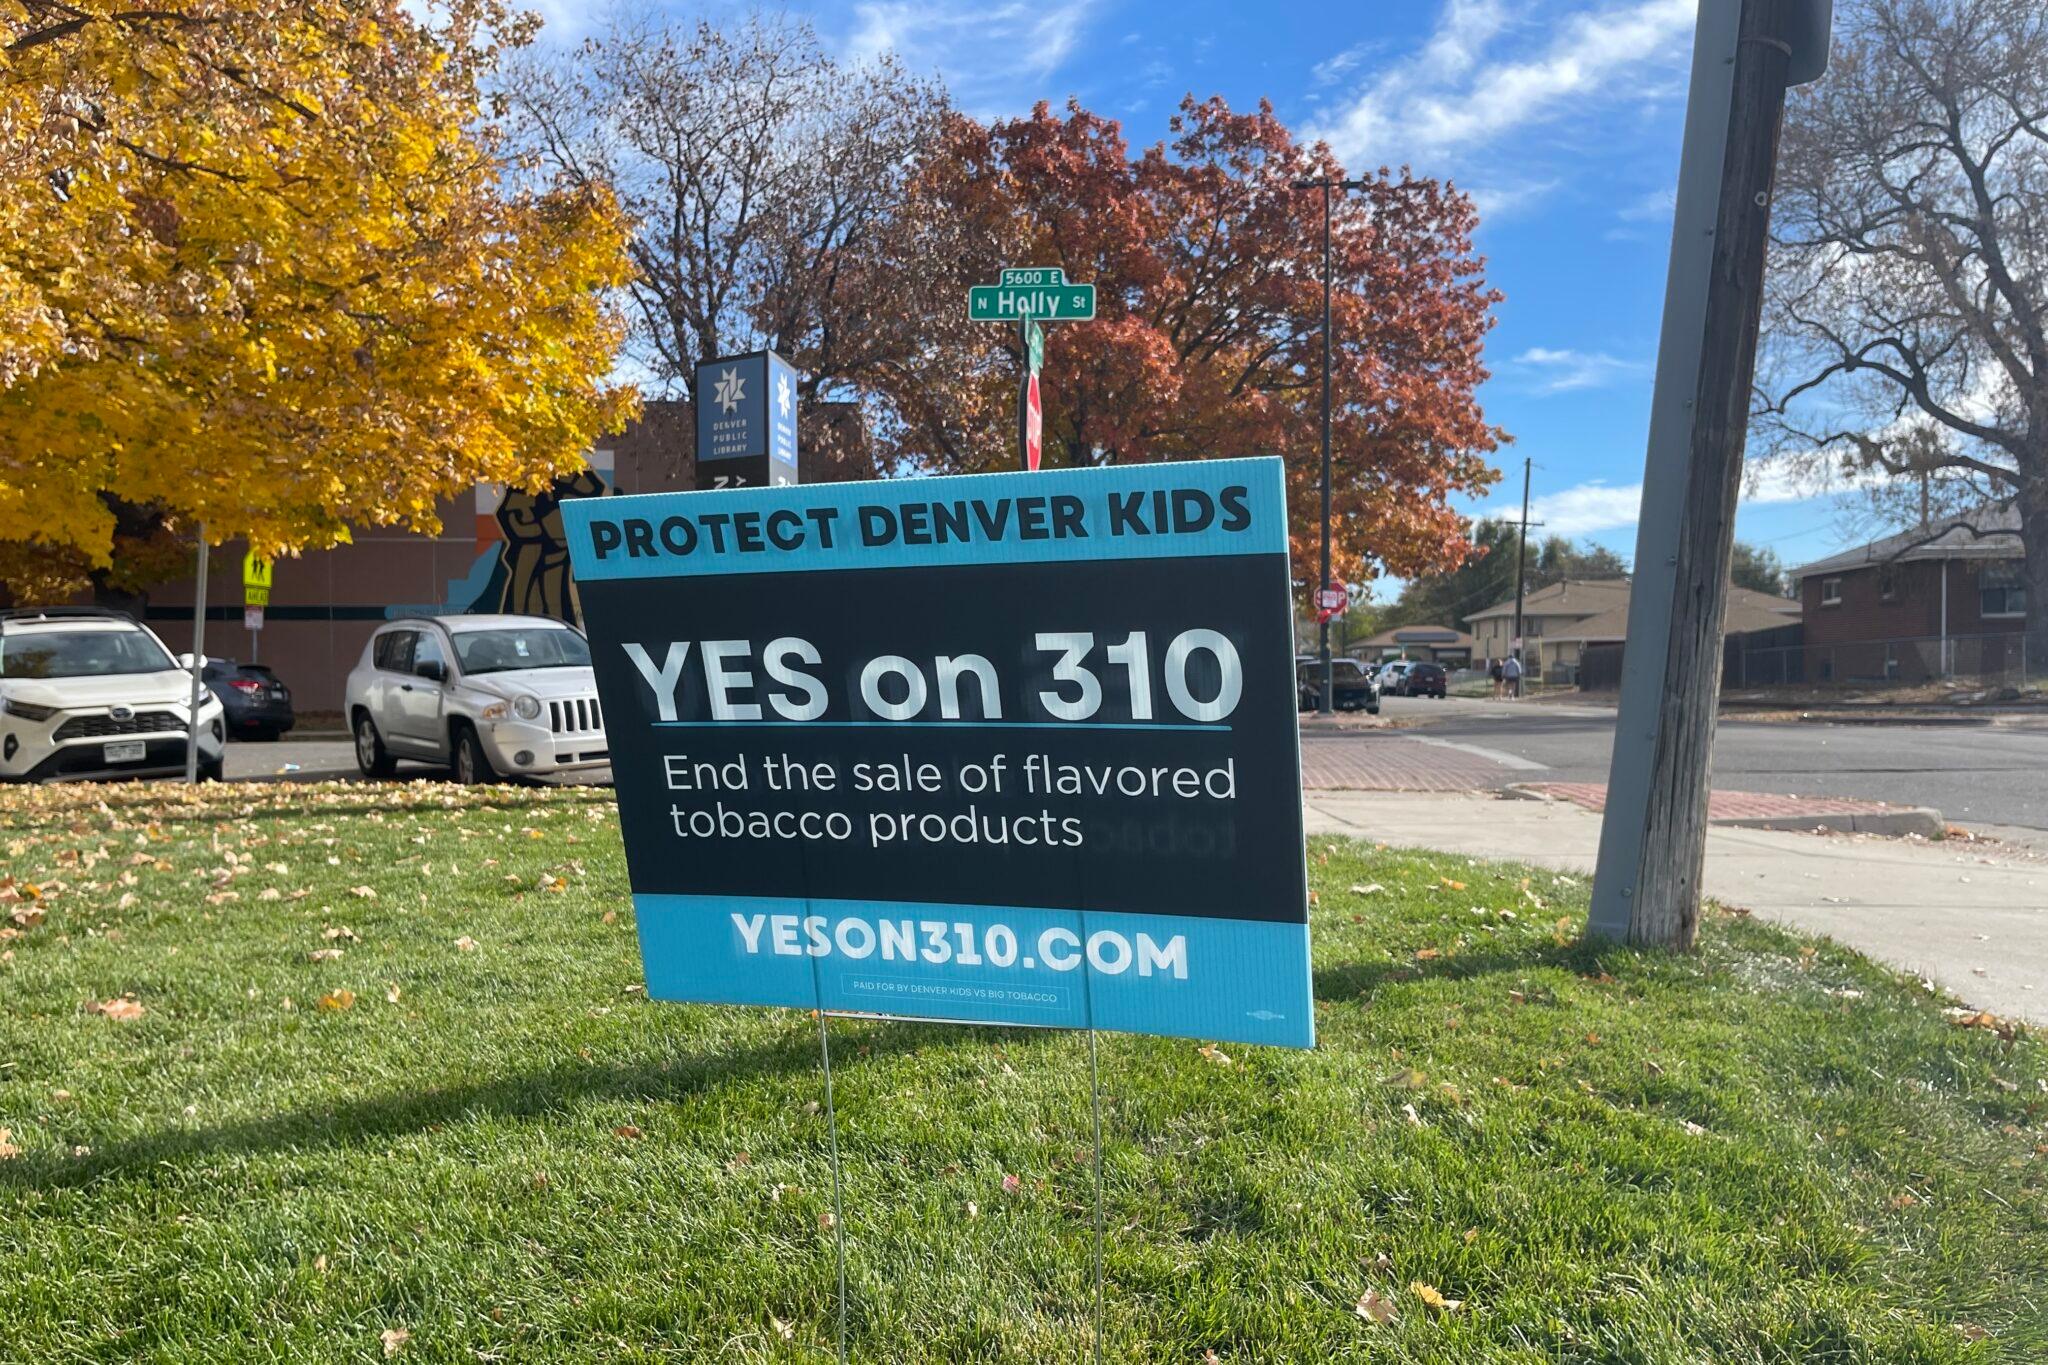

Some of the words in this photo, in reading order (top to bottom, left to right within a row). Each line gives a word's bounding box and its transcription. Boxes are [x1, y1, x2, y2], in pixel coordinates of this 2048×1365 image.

[1005, 271, 1042, 284] 5600
[1050, 271, 1059, 284] E
[977, 297, 988, 310] N
[998, 291, 1060, 317] Holly
[1072, 295, 1086, 308] St
[713, 418, 747, 431] DENVER
[713, 431, 747, 443] PUBLIC
[713, 443, 747, 455] LIBRARY
[589, 507, 839, 560] PROTECT
[857, 494, 1090, 547] DENVER
[1108, 485, 1252, 537] KIDS
[620, 636, 830, 722] YES
[860, 653, 1003, 721] on
[1034, 628, 1244, 722] 310
[663, 753, 749, 790] End
[763, 753, 836, 791] the
[853, 753, 942, 792] sale
[959, 754, 1007, 793] of
[1023, 754, 1237, 799] flavored
[670, 801, 852, 840] tobacco
[869, 804, 1084, 848] products
[730, 912, 1190, 980] YESON310.COM
[853, 980, 875, 991] PAID
[876, 982, 895, 992] FOR
[897, 984, 910, 993] BY
[911, 984, 948, 995] DENVER
[950, 987, 972, 997] KIDS
[973, 988, 986, 998] VS
[988, 989, 1005, 999] BIG
[1007, 991, 1058, 1003] TOBACCO
